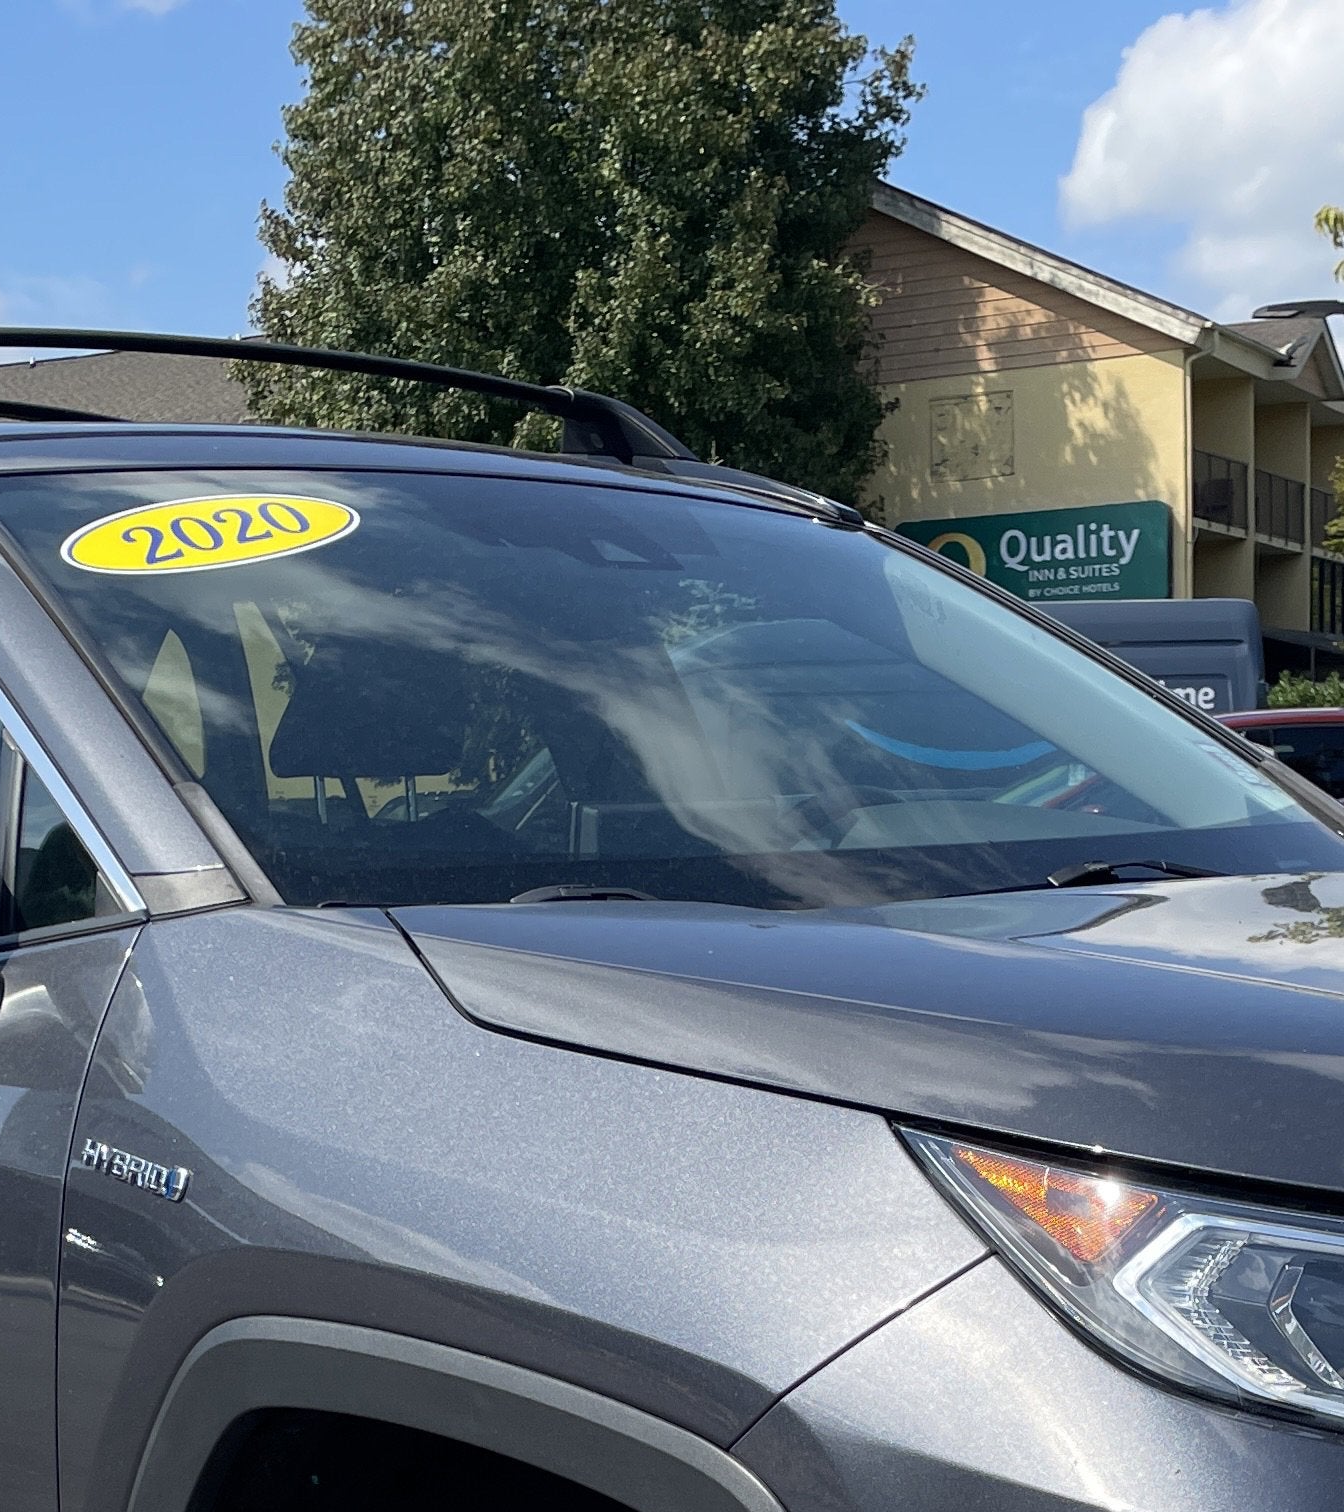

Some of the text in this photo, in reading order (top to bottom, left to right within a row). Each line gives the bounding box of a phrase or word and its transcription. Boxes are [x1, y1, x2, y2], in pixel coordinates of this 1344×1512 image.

[122, 502, 311, 565] 2020
[999, 522, 1141, 572] Quality
[1028, 563, 1121, 582] INN & SUITES
[1028, 582, 1120, 598] BY CHOICE HOTELS
